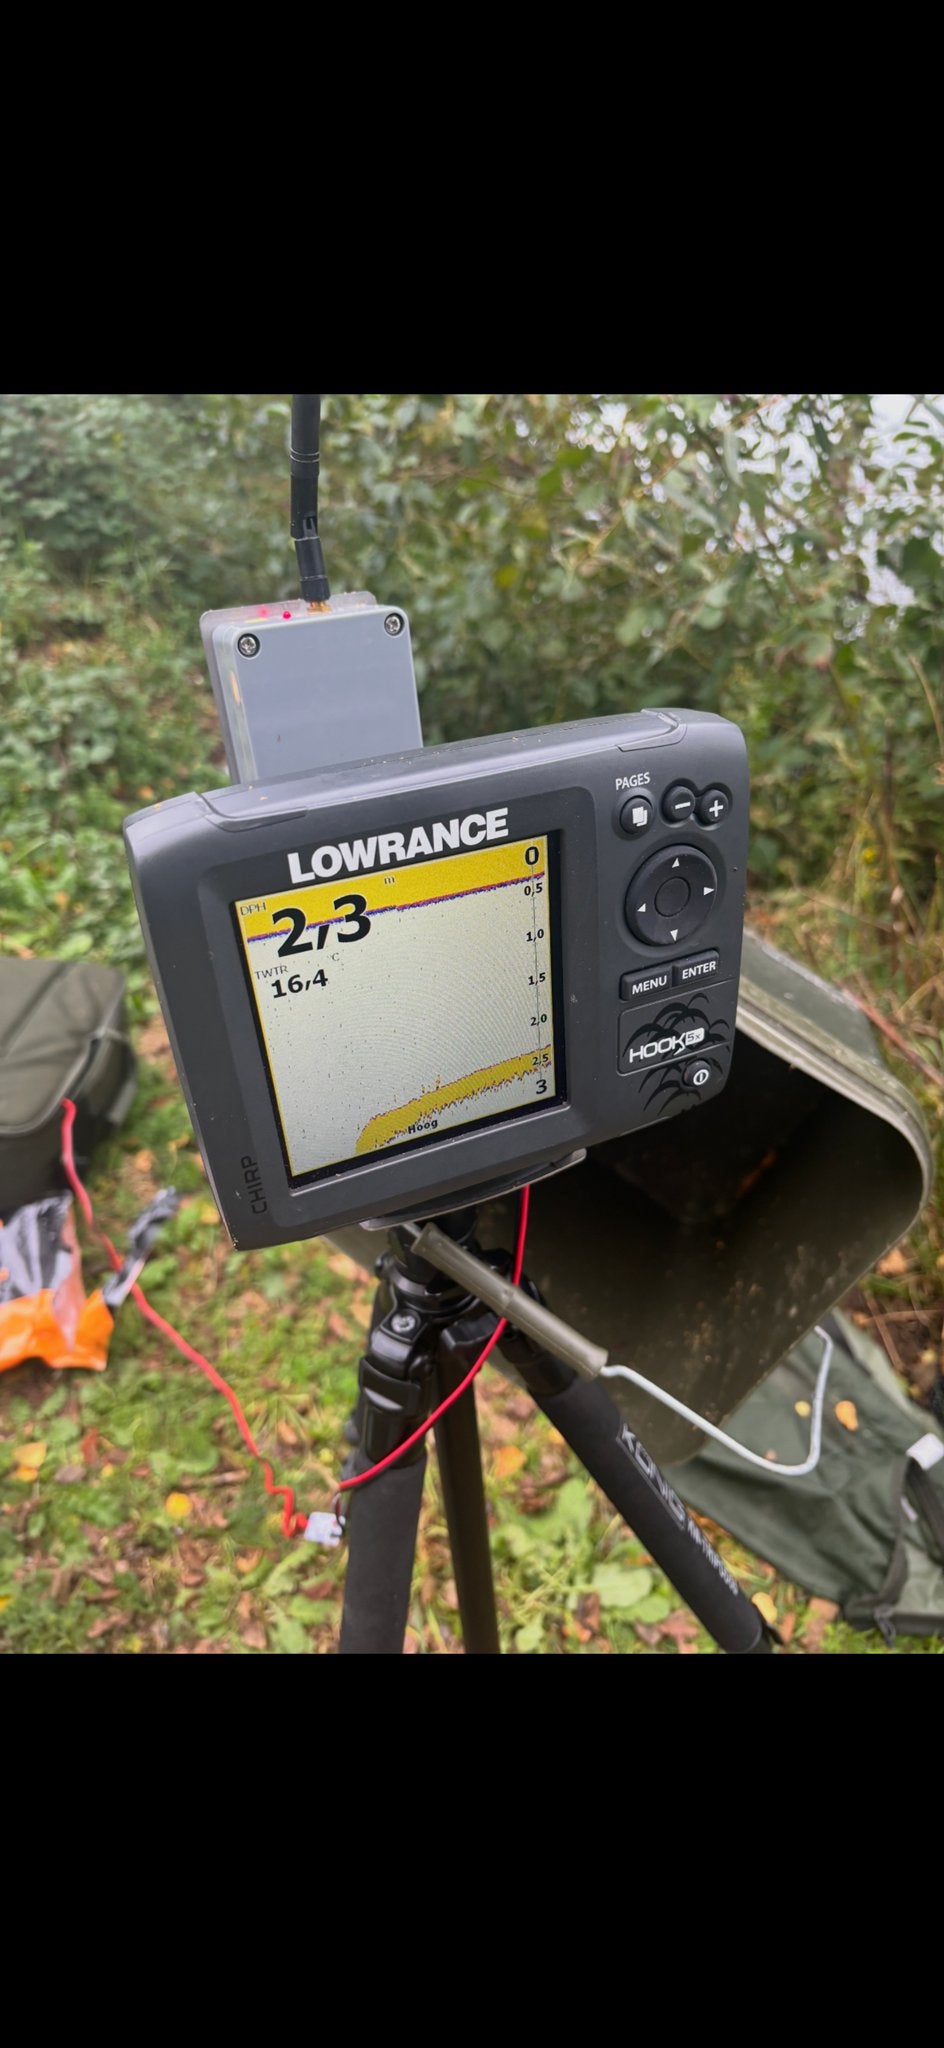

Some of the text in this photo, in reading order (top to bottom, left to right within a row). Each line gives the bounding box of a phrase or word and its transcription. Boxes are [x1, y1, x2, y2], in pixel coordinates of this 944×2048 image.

[615, 772, 650, 790] PAGES
[287, 807, 509, 884] LOWRANCE
[524, 846, 540, 866] 0
[384, 876, 395, 885] m
[524, 882, 543, 897] 0,5
[240, 902, 266, 916] DPH
[272, 894, 371, 958] 2,3
[525, 928, 544, 943] 1,0
[255, 965, 288, 980] TWTR
[682, 961, 716, 979] ENTER
[271, 969, 328, 998] 16,4
[528, 972, 546, 987] 1,5
[631, 976, 667, 994] MENU
[530, 1013, 547, 1027] 2,0
[629, 1032, 686, 1063] HOOK
[532, 1053, 549, 1067] 2,5
[535, 1079, 548, 1095] 3
[407, 1118, 438, 1134] Hoog
[240, 1156, 268, 1214] CHIRP
